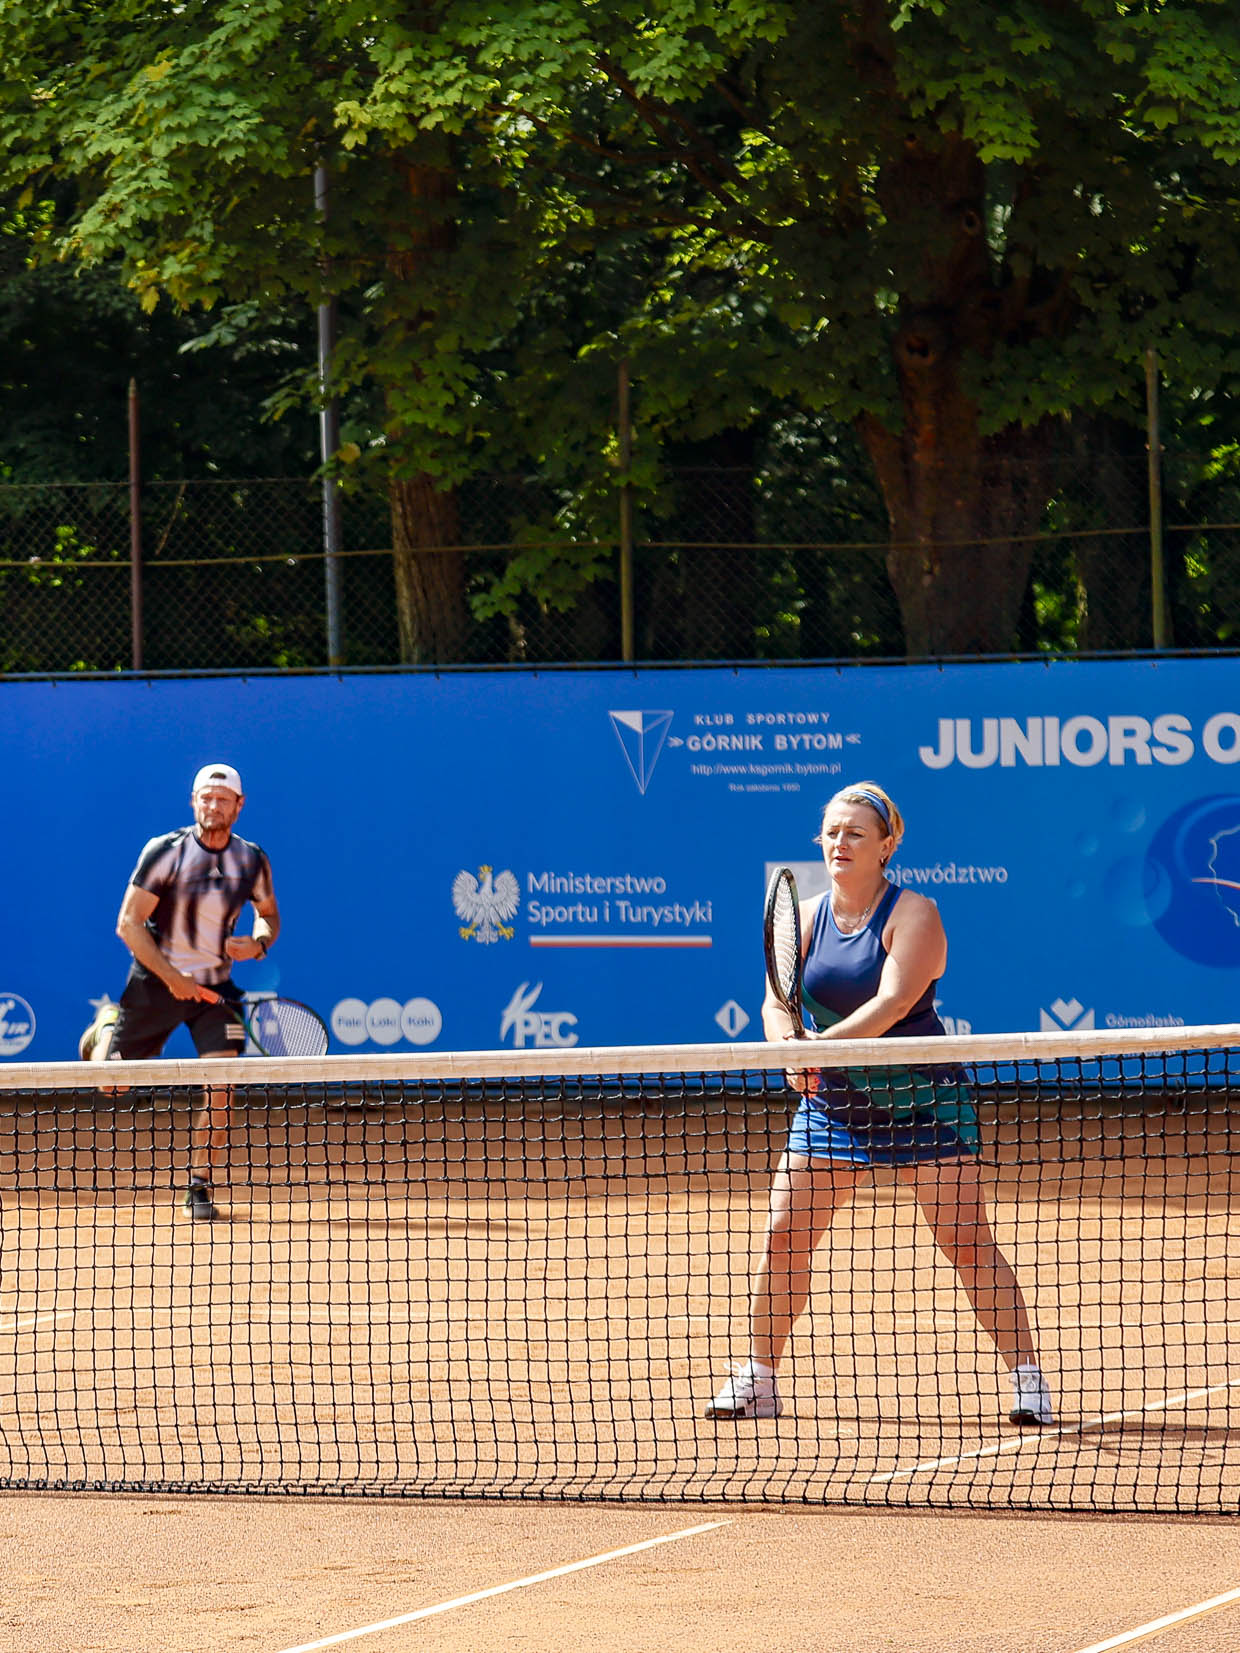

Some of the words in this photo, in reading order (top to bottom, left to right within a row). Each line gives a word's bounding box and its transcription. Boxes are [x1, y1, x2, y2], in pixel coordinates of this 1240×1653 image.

[694, 713, 735, 726] KLUB
[746, 712, 831, 725] SPORTOWY
[686, 732, 764, 751] GÓRNIK
[775, 733, 843, 750] BYTOM
[918, 714, 1195, 769] JUNIORS
[527, 871, 667, 894] Ministerstwo
[882, 861, 1008, 888] ojewództwo
[527, 901, 598, 927] Sportu
[603, 901, 610, 923] i
[615, 900, 713, 927] Turystyki
